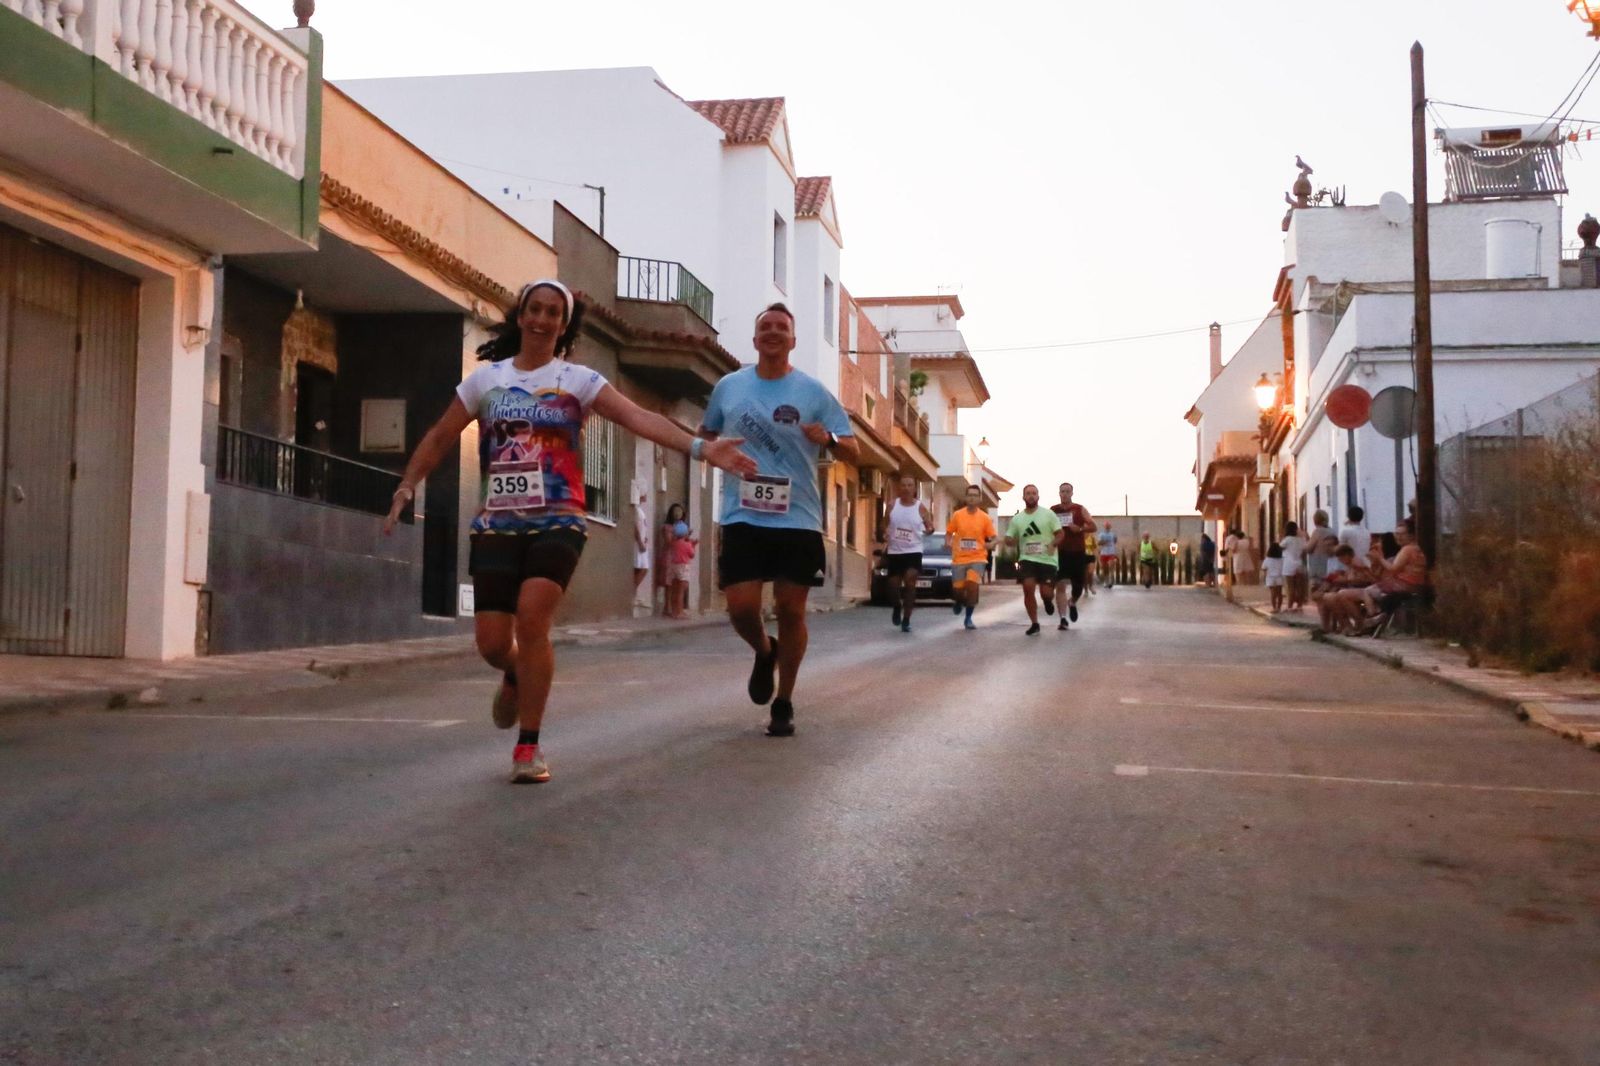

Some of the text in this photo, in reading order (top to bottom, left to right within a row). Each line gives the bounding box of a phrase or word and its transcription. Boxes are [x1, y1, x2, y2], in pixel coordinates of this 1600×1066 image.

[501, 391, 520, 406] Las
[740, 411, 780, 456] NOCTURNA
[492, 475, 529, 494] 359
[754, 485, 774, 500] 85
